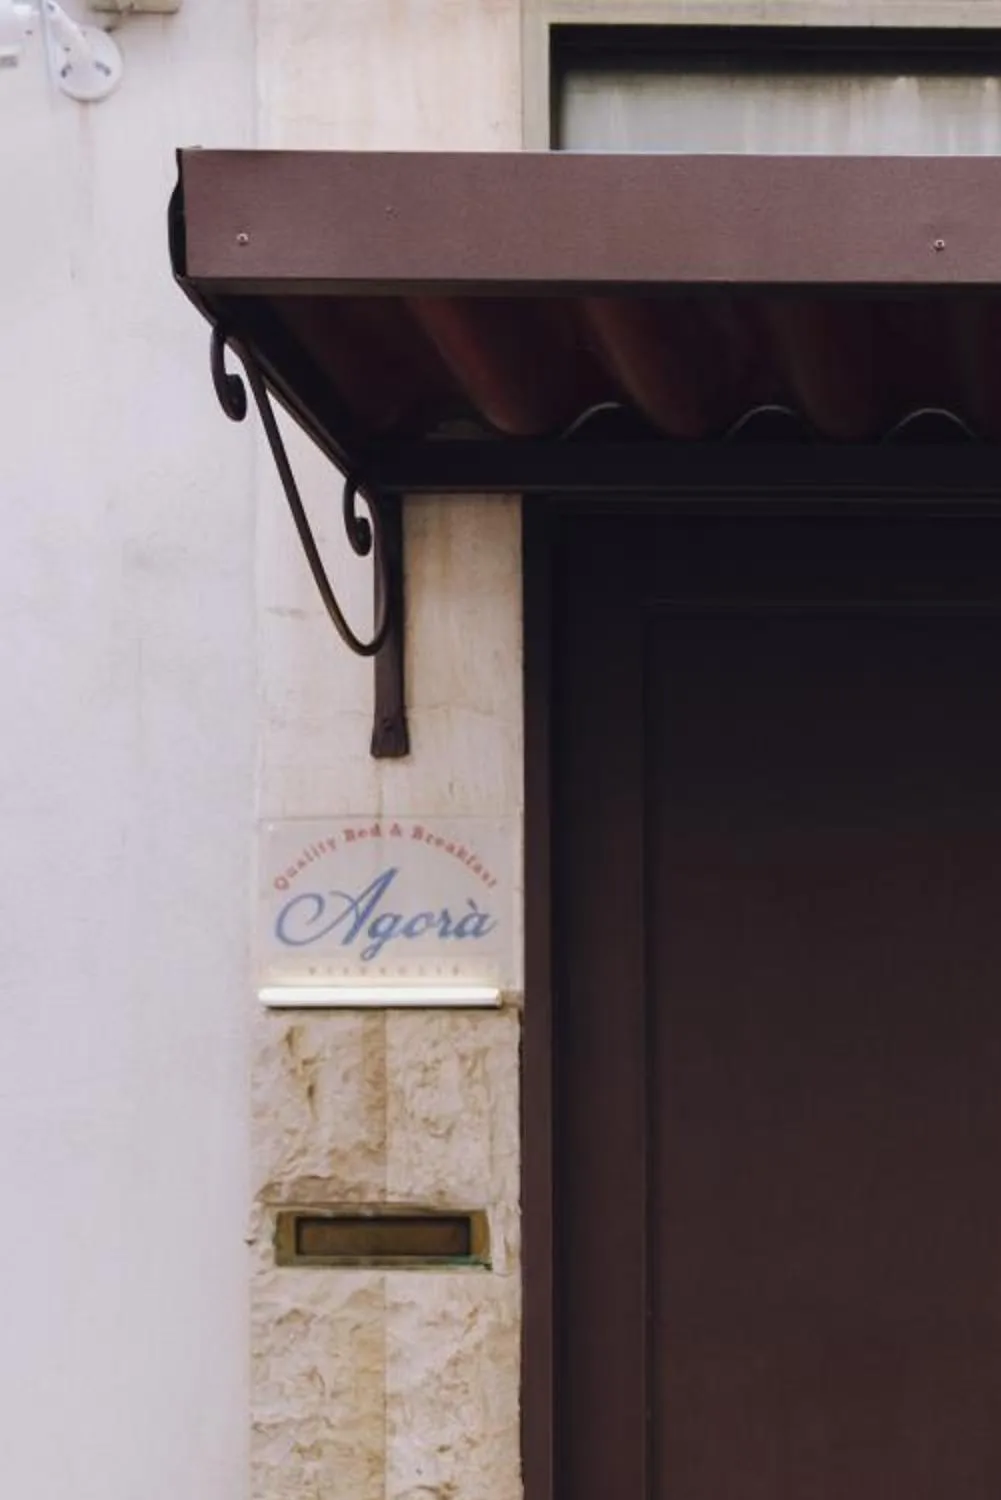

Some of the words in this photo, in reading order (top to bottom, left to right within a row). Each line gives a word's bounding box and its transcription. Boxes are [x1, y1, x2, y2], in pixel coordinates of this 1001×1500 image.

[273, 836, 337, 891] Quality
[343, 823, 382, 842] Bed
[411, 824, 497, 888] Breakfast
[275, 866, 498, 961] Agorà
